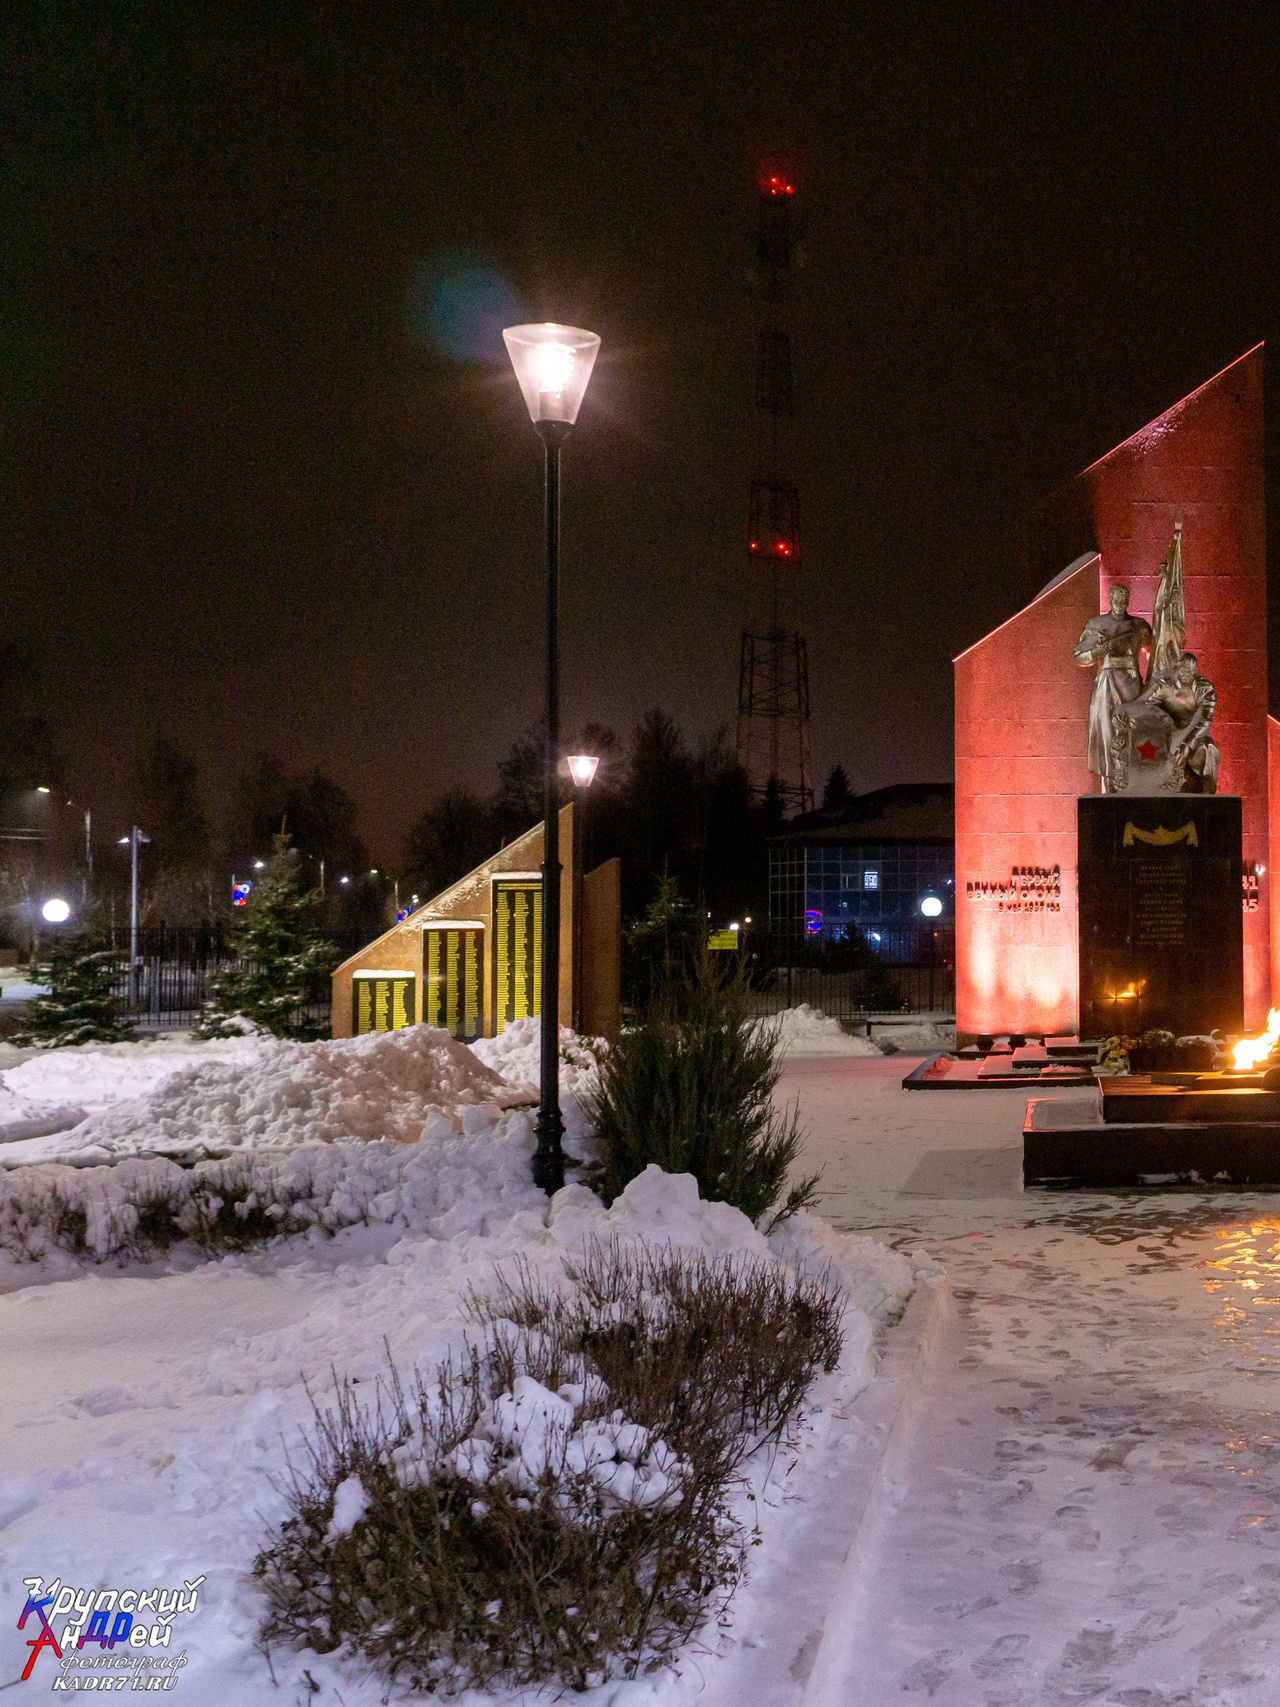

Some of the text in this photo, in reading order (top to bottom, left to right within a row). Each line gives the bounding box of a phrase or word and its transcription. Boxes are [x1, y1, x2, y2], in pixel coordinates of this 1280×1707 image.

[1011, 872, 1061, 887] ПЕРВЫЙ
[967, 888, 1061, 901] ВЕЧНЫЙ ОГОНЬ
